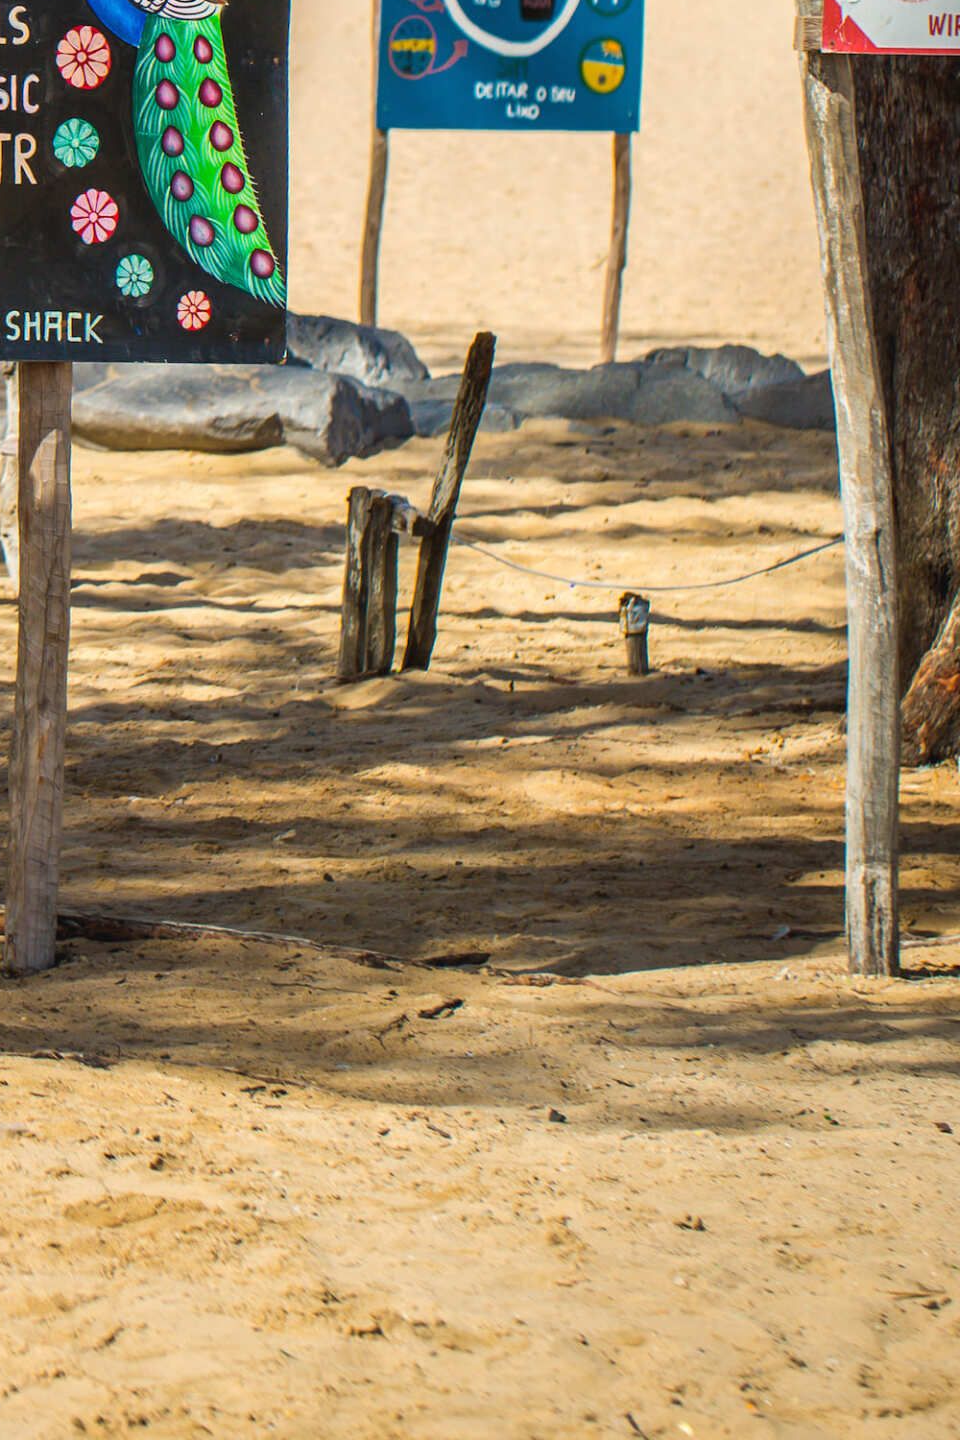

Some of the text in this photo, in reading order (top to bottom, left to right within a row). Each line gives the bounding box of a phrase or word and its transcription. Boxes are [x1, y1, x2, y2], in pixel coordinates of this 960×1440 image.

[475, 81, 528, 99] DEITAR
[536, 85, 547, 102] O
[506, 104, 540, 120] LIXO
[6, 310, 104, 344] SHACK
